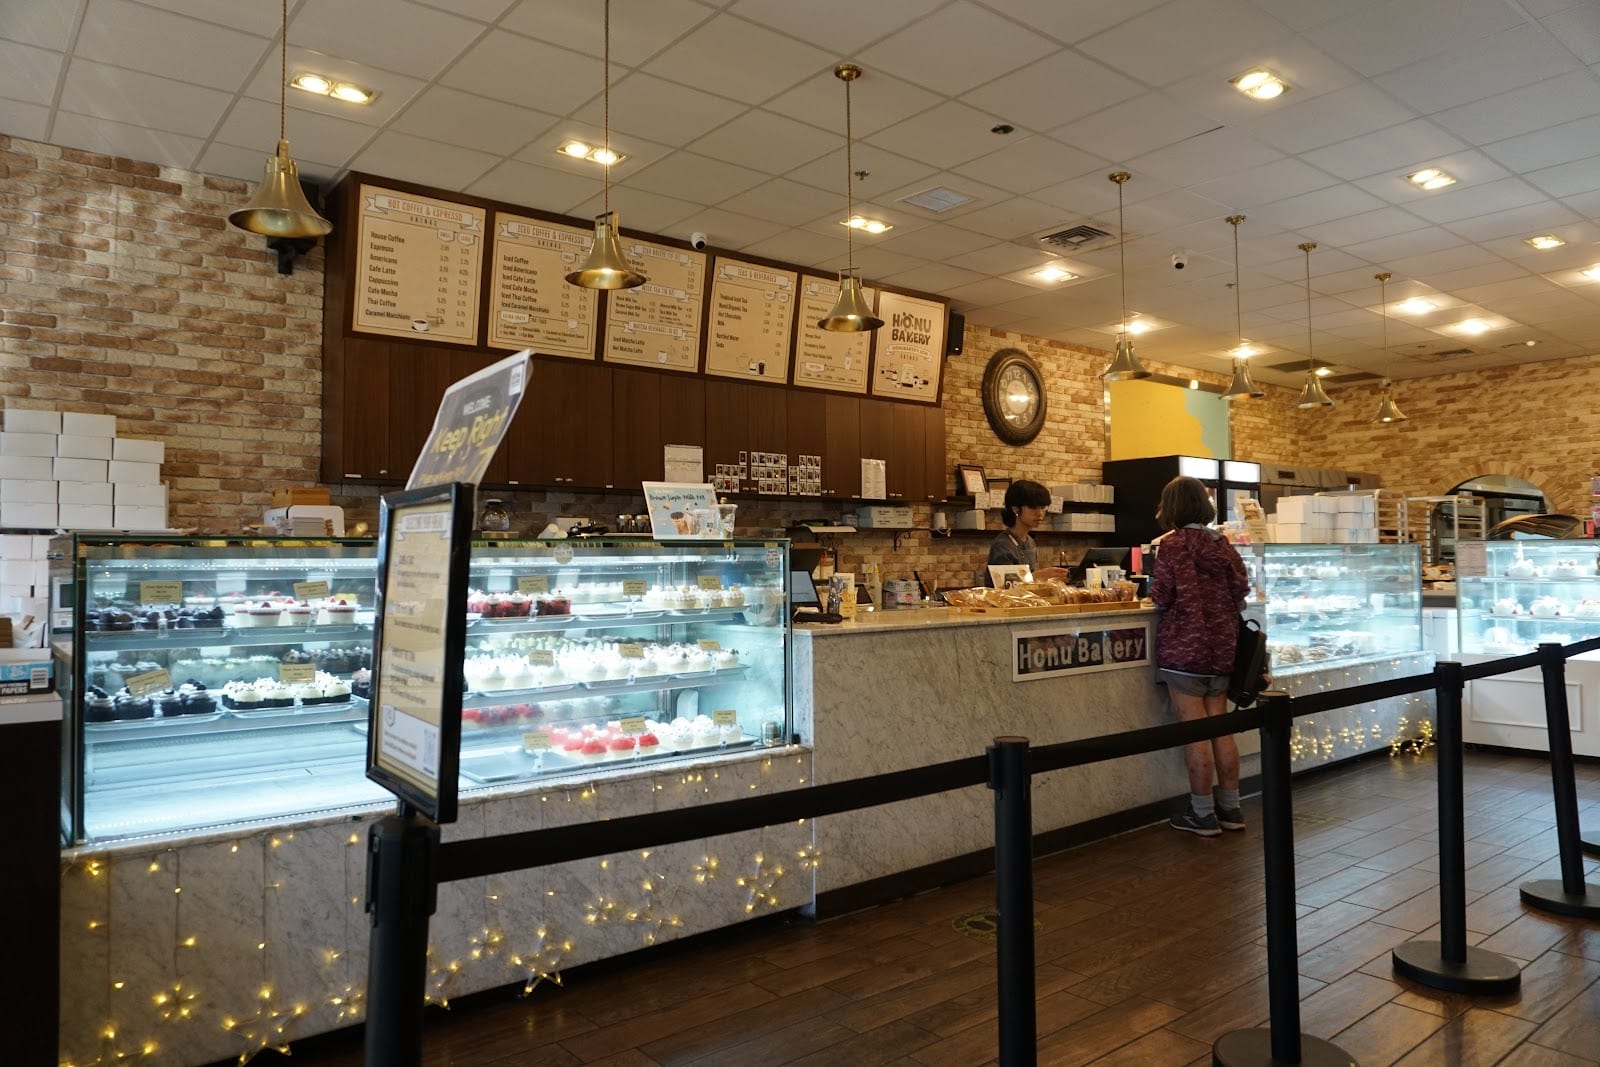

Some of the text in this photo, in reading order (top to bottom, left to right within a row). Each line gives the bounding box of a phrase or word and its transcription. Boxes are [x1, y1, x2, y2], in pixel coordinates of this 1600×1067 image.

[388, 198, 400, 209] HOT
[402, 201, 423, 214] COFFEE
[432, 208, 463, 221] ESPRESSO
[371, 231, 405, 243] House Coffee
[532, 226, 550, 238] COFFEE
[559, 232, 584, 244] ESPRESSO
[370, 242, 394, 253] Espresso
[370, 254, 398, 264] Americano
[514, 256, 529, 265] Coffee
[382, 266, 396, 275] Latte
[514, 267, 537, 275] Americano
[369, 275, 398, 286] Cappuccino
[381, 289, 398, 297] Mocha
[379, 299, 396, 307] Coffee
[366, 309, 411, 320] Caramel Macchiato
[892, 312, 931, 333] HONU
[892, 329, 931, 346] BAKERY
[1013, 369, 1021, 378] 12
[430, 406, 509, 456] Keep Right
[1019, 636, 1143, 669] Honu Bakery
